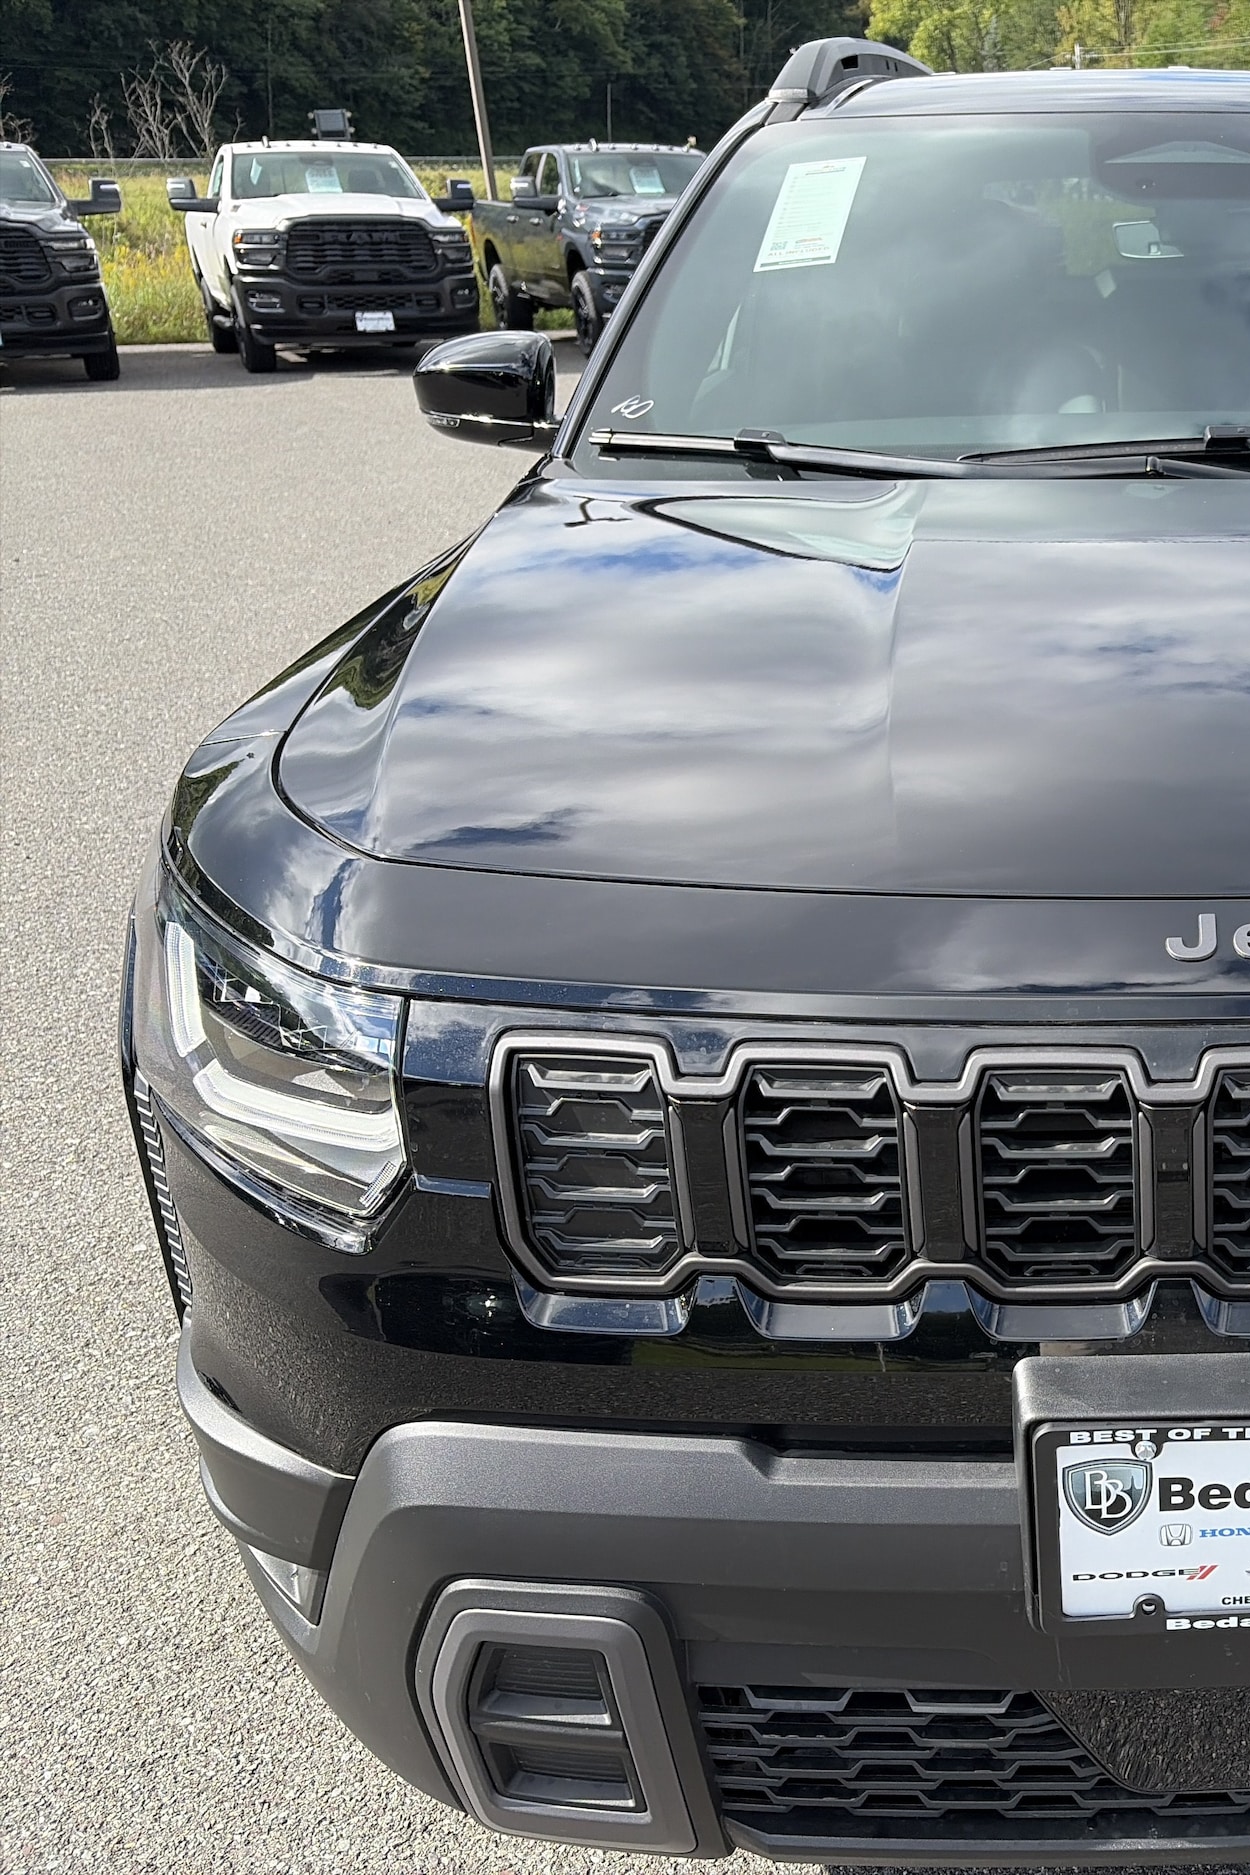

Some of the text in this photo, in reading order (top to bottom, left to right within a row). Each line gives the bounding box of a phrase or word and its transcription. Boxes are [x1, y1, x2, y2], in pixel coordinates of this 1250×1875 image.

[1069, 1429, 1157, 1444] BEST
[1167, 1428, 1212, 1440] OF
[1072, 1568, 1201, 1581] DODGE
